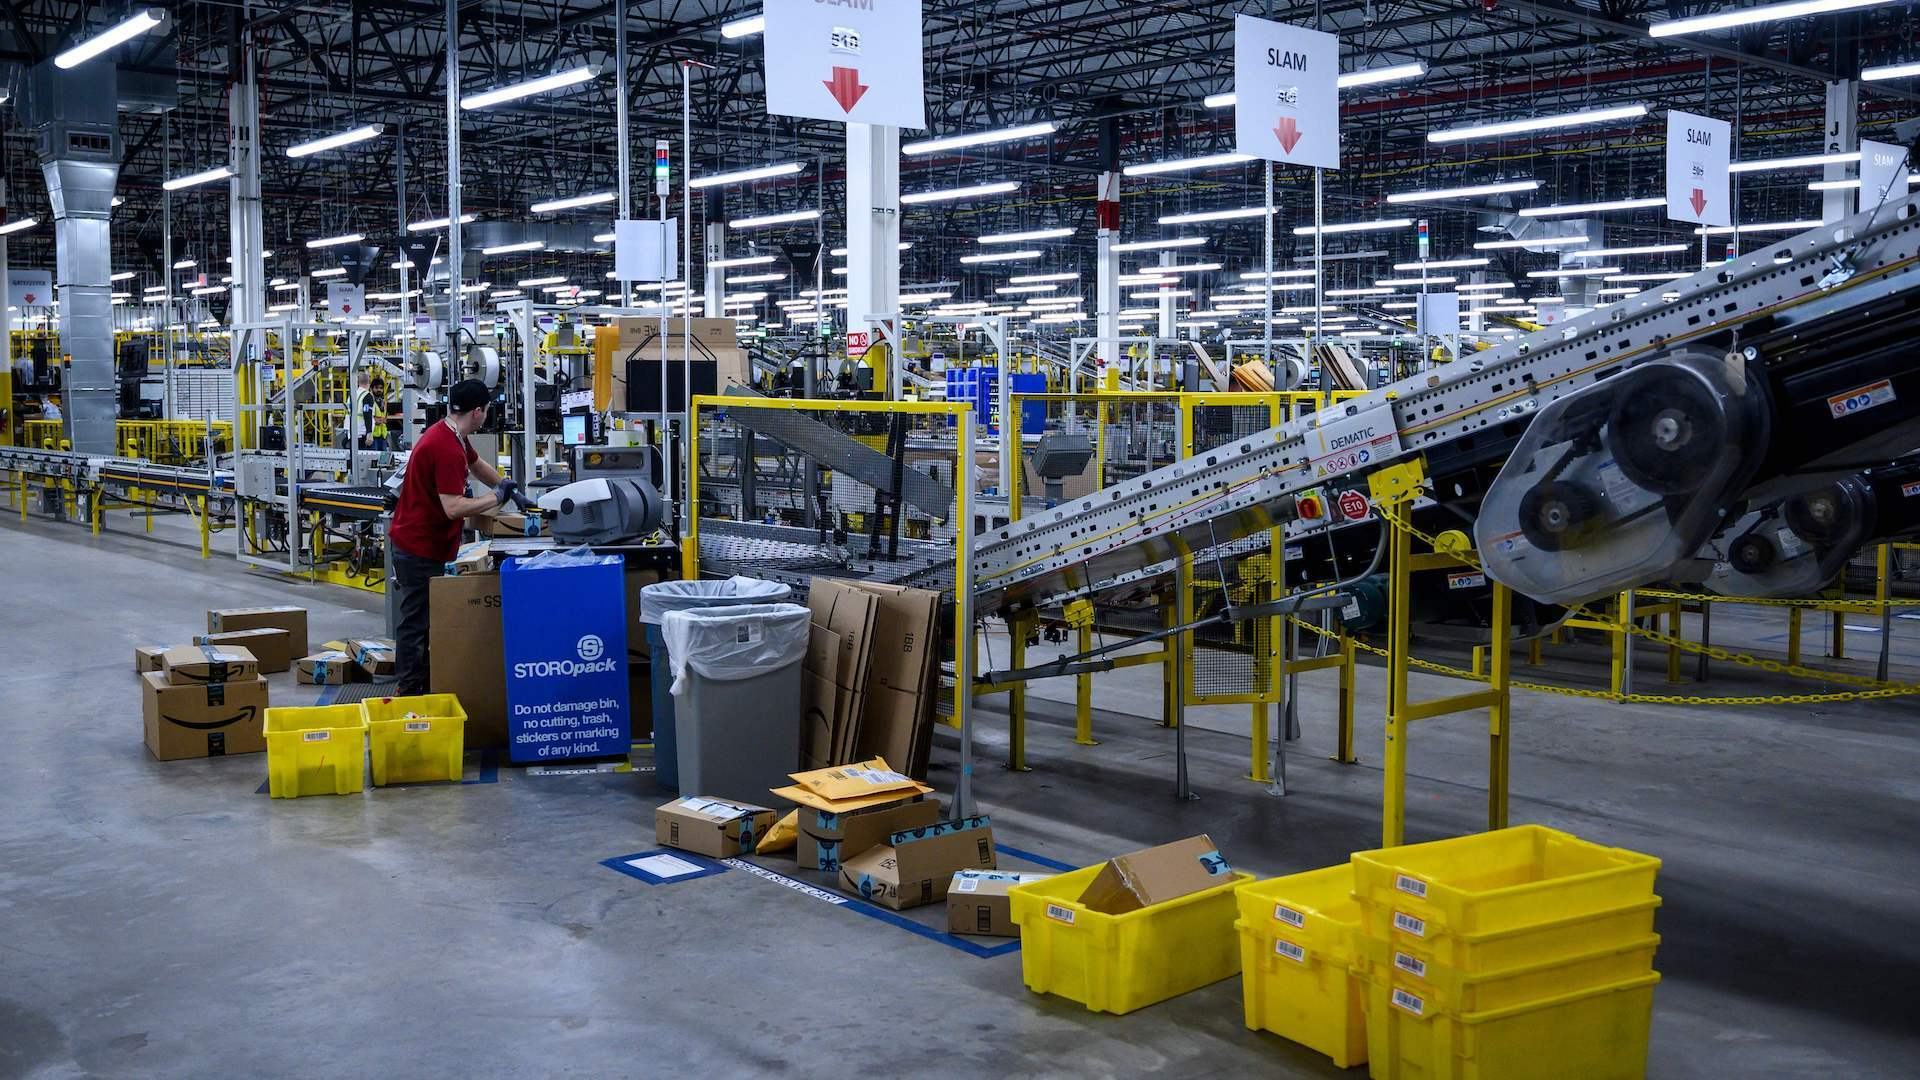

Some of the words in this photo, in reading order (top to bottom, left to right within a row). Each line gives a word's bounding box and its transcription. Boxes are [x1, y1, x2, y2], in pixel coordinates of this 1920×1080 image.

[1268, 48, 1307, 72] SLAM
[1830, 121, 1840, 137] J
[1687, 128, 1712, 147] SLAM
[1873, 153, 1894, 167] SLAM
[848, 335, 859, 347] NO
[1331, 427, 1375, 450] DEMATIC
[1343, 500, 1363, 513] E10
[514, 658, 617, 679] STOROpack
[514, 704, 532, 715] Do
[533, 704, 551, 714] not
[553, 702, 598, 712] damage
[599, 698, 619, 709] bin,
[523, 719, 538, 729] no
[540, 716, 580, 728] cutting,
[582, 713, 613, 724] trash,
[516, 732, 559, 743] stickers
[560, 732, 573, 740] or
[574, 727, 619, 739] marking
[538, 745, 550, 756] of
[551, 746, 572, 757] any
[573, 742, 600, 753] kind.
